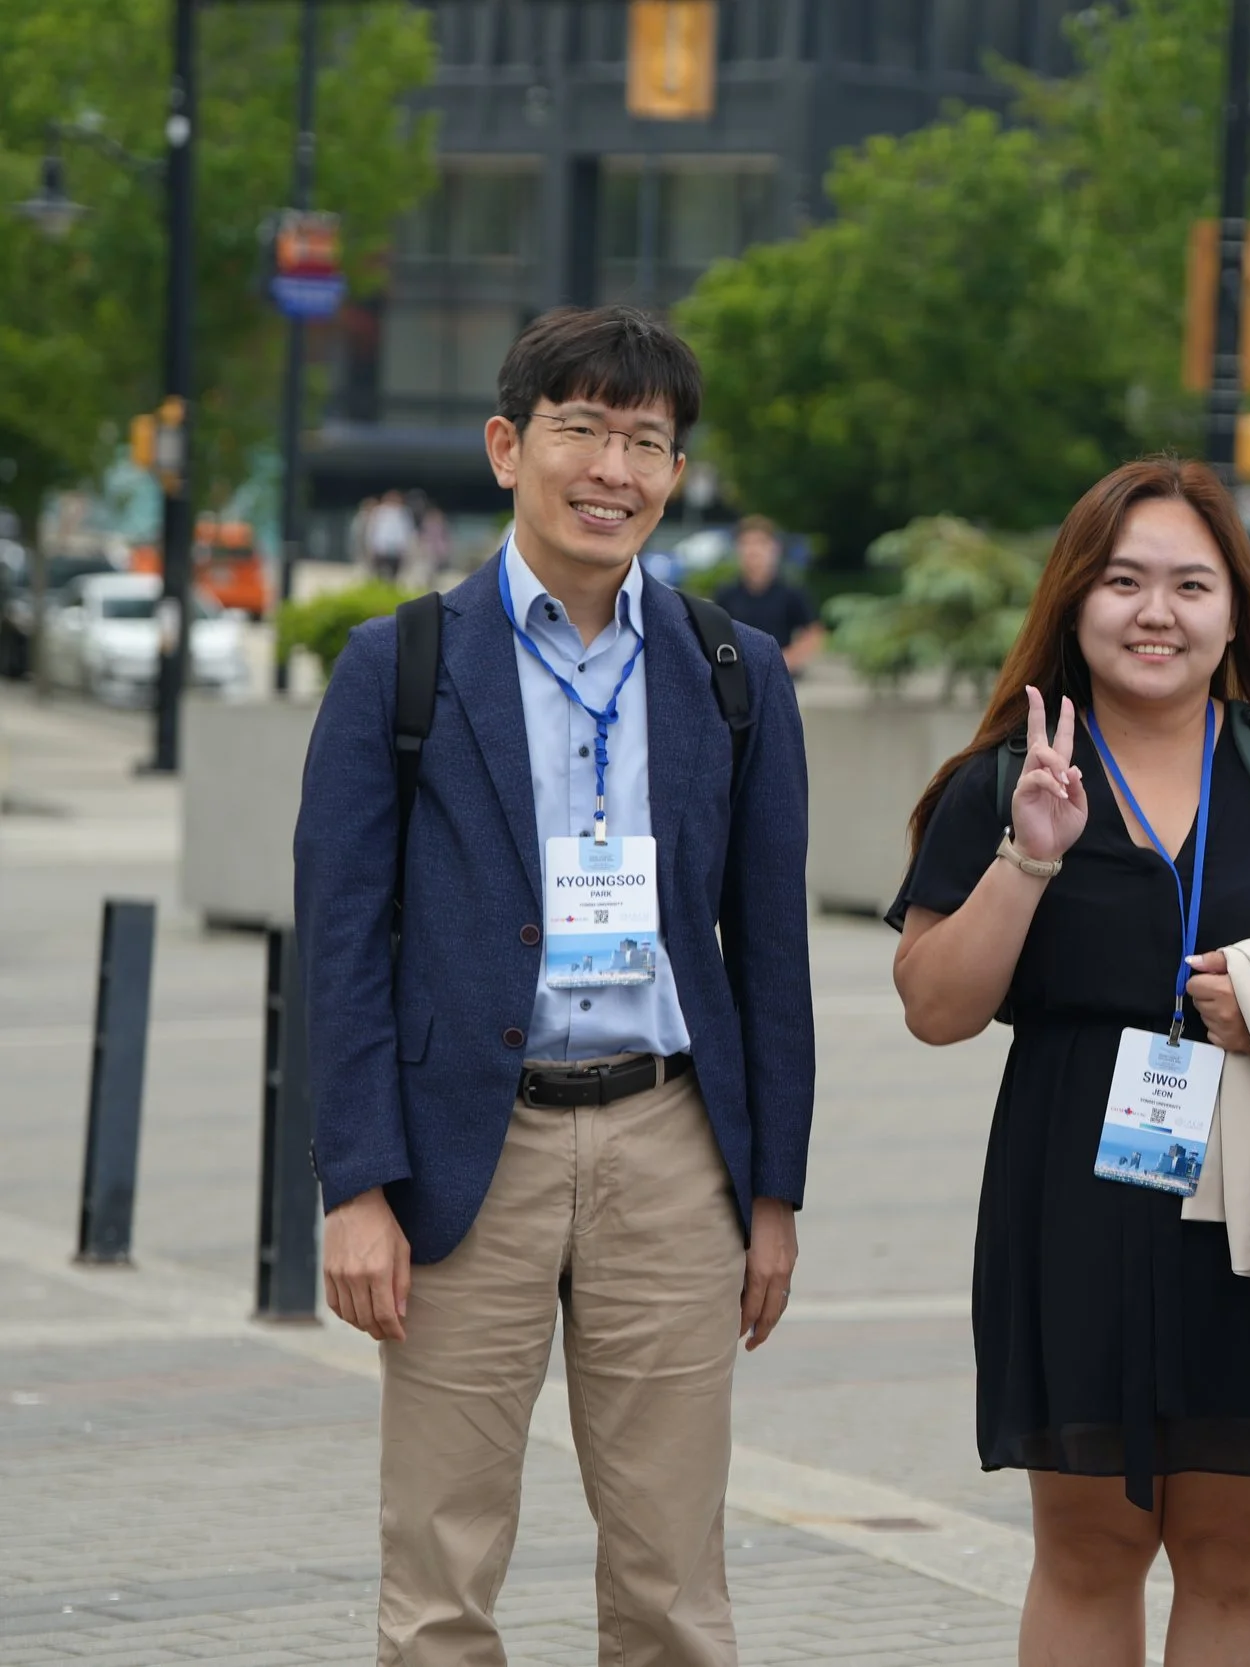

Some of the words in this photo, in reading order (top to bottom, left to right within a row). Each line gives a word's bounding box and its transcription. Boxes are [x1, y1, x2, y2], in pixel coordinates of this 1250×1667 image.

[556, 874, 646, 888] KYOUNGSOO
[590, 890, 612, 898] PARK
[1142, 1071, 1188, 1090] SIWOO
[1152, 1088, 1174, 1099] JEON
